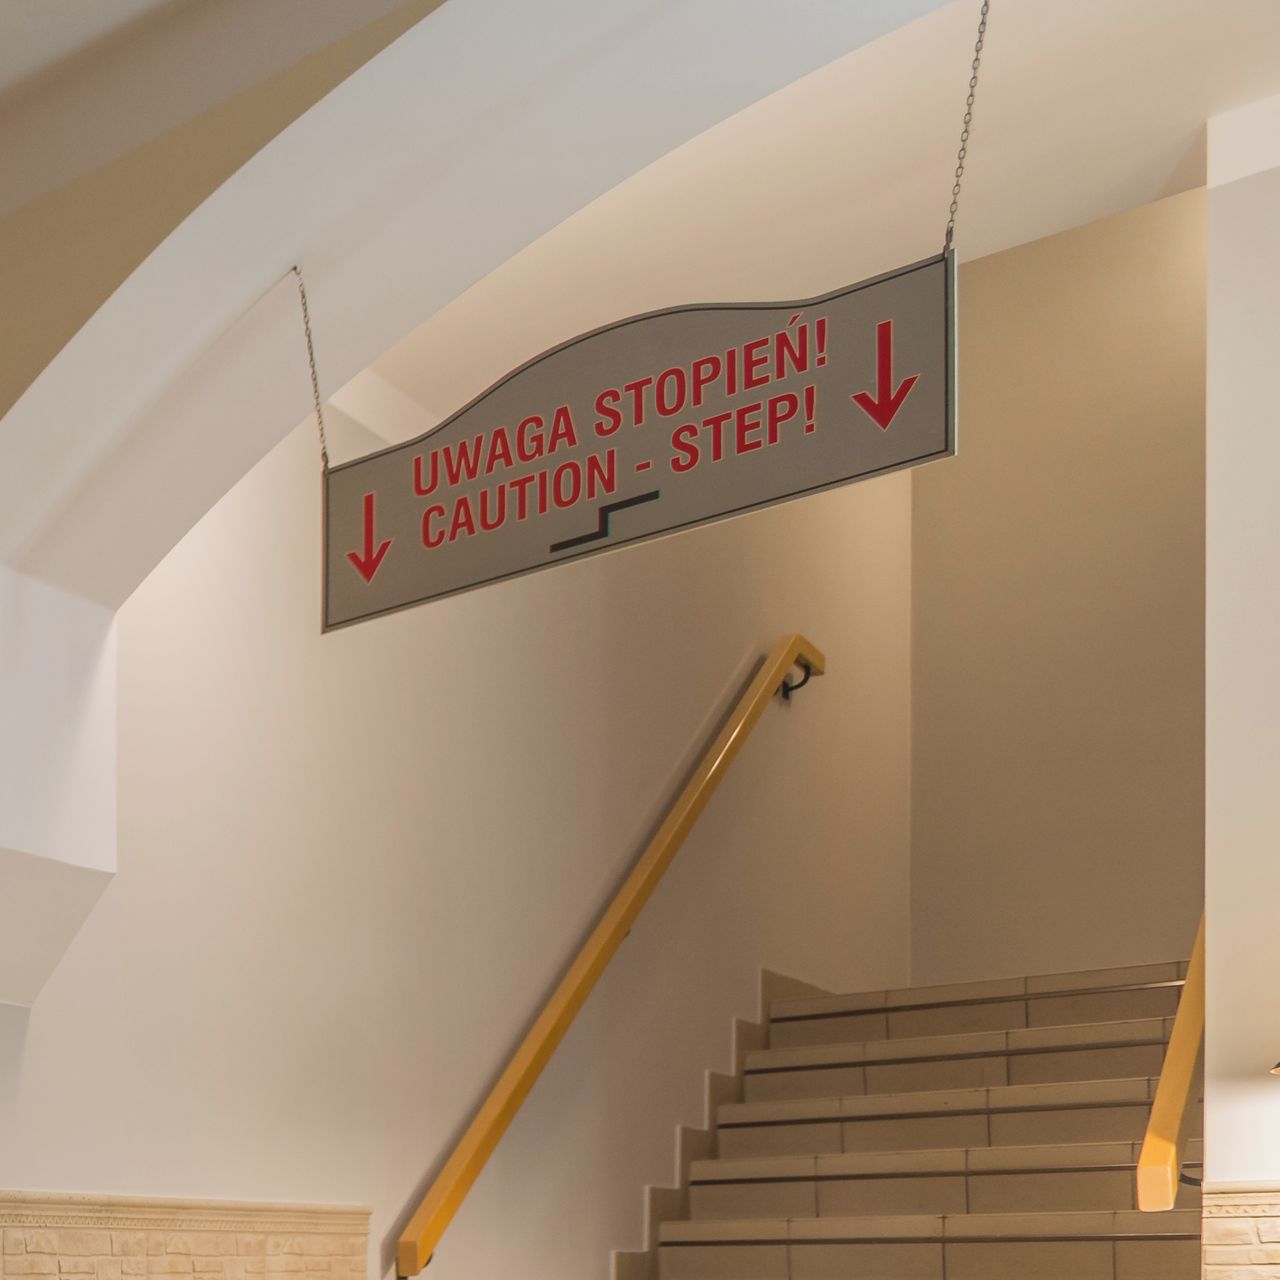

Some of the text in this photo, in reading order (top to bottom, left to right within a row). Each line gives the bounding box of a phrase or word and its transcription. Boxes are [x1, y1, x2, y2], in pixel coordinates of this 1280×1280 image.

[412, 312, 829, 497] UWAGA STOPIEŃ!
[420, 448, 616, 549] CAUTION
[670, 385, 817, 473] STEP!
